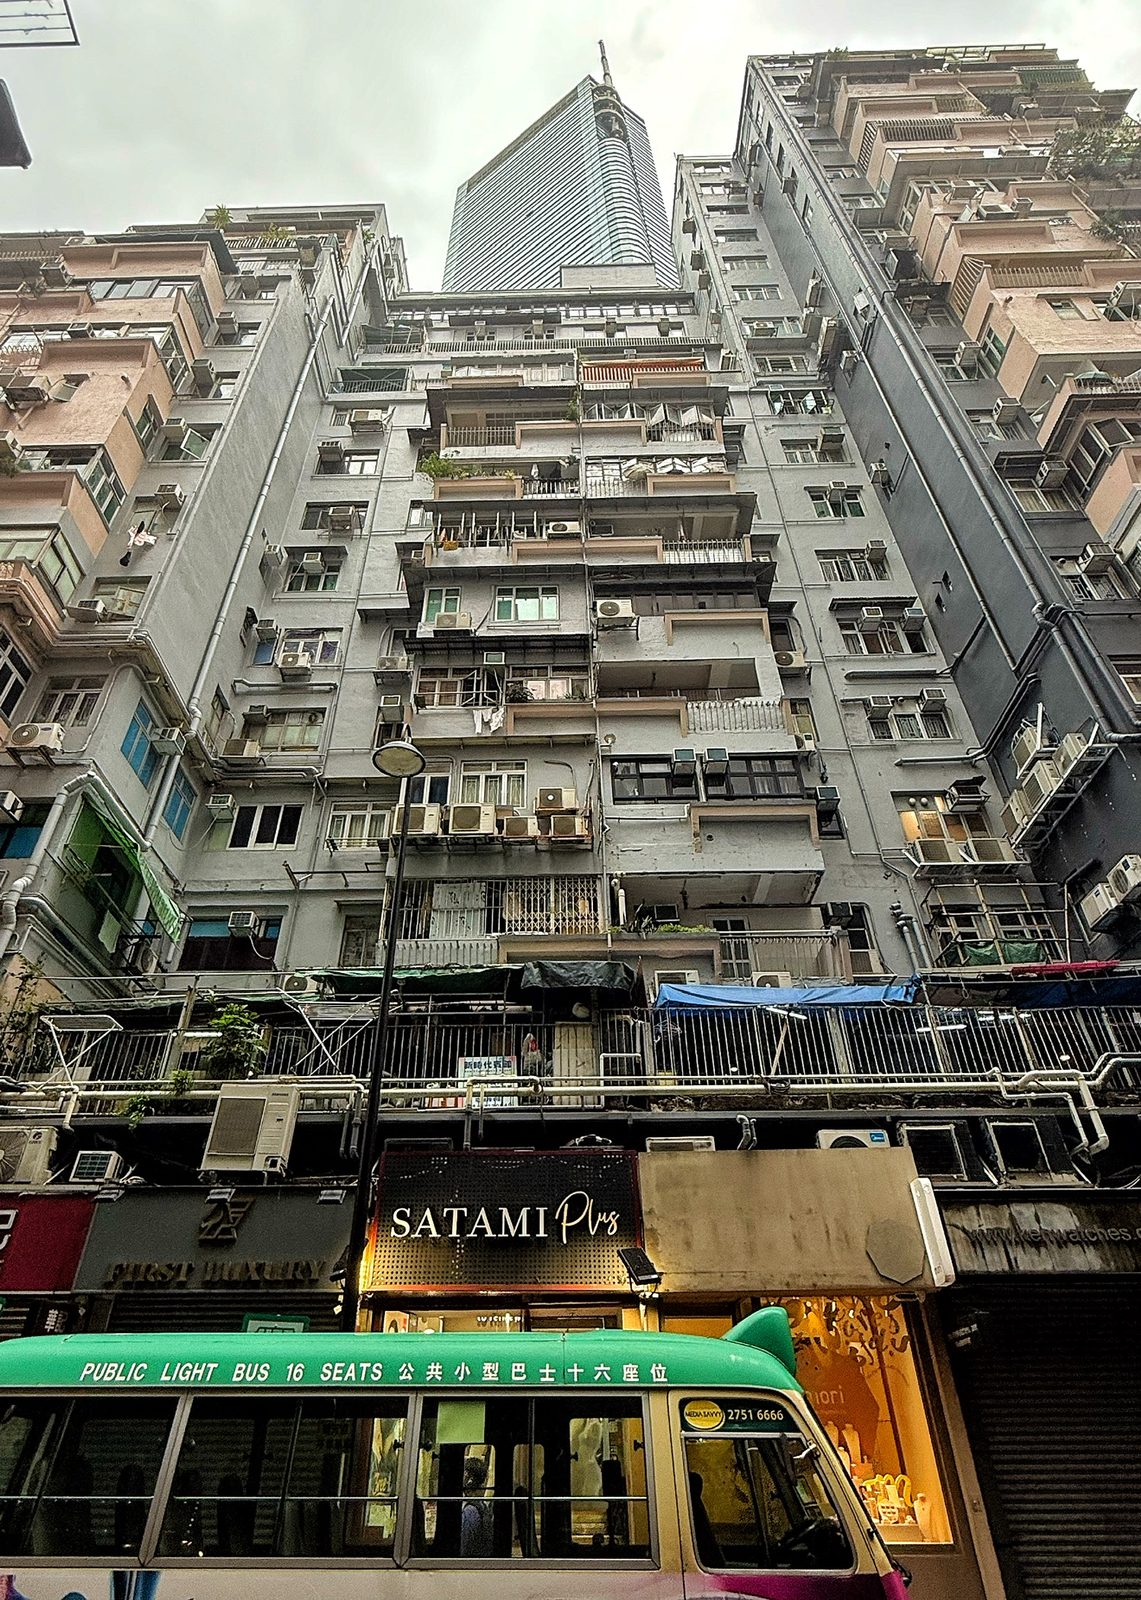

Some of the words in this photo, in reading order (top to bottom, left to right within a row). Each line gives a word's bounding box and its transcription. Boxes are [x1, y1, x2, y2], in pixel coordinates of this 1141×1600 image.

[390, 1206, 548, 1238] SATAMI
[555, 1190, 620, 1245] Plus
[79, 1362, 148, 1382] PUBLIC
[160, 1362, 218, 1382] LIGHT
[231, 1362, 271, 1382] BUS
[286, 1362, 305, 1382] 16
[320, 1362, 384, 1382] SEATS
[398, 1361, 669, 1382] 公共小型巴士十六座位
[727, 1409, 754, 1421] 2751
[757, 1409, 784, 1421] 6666
